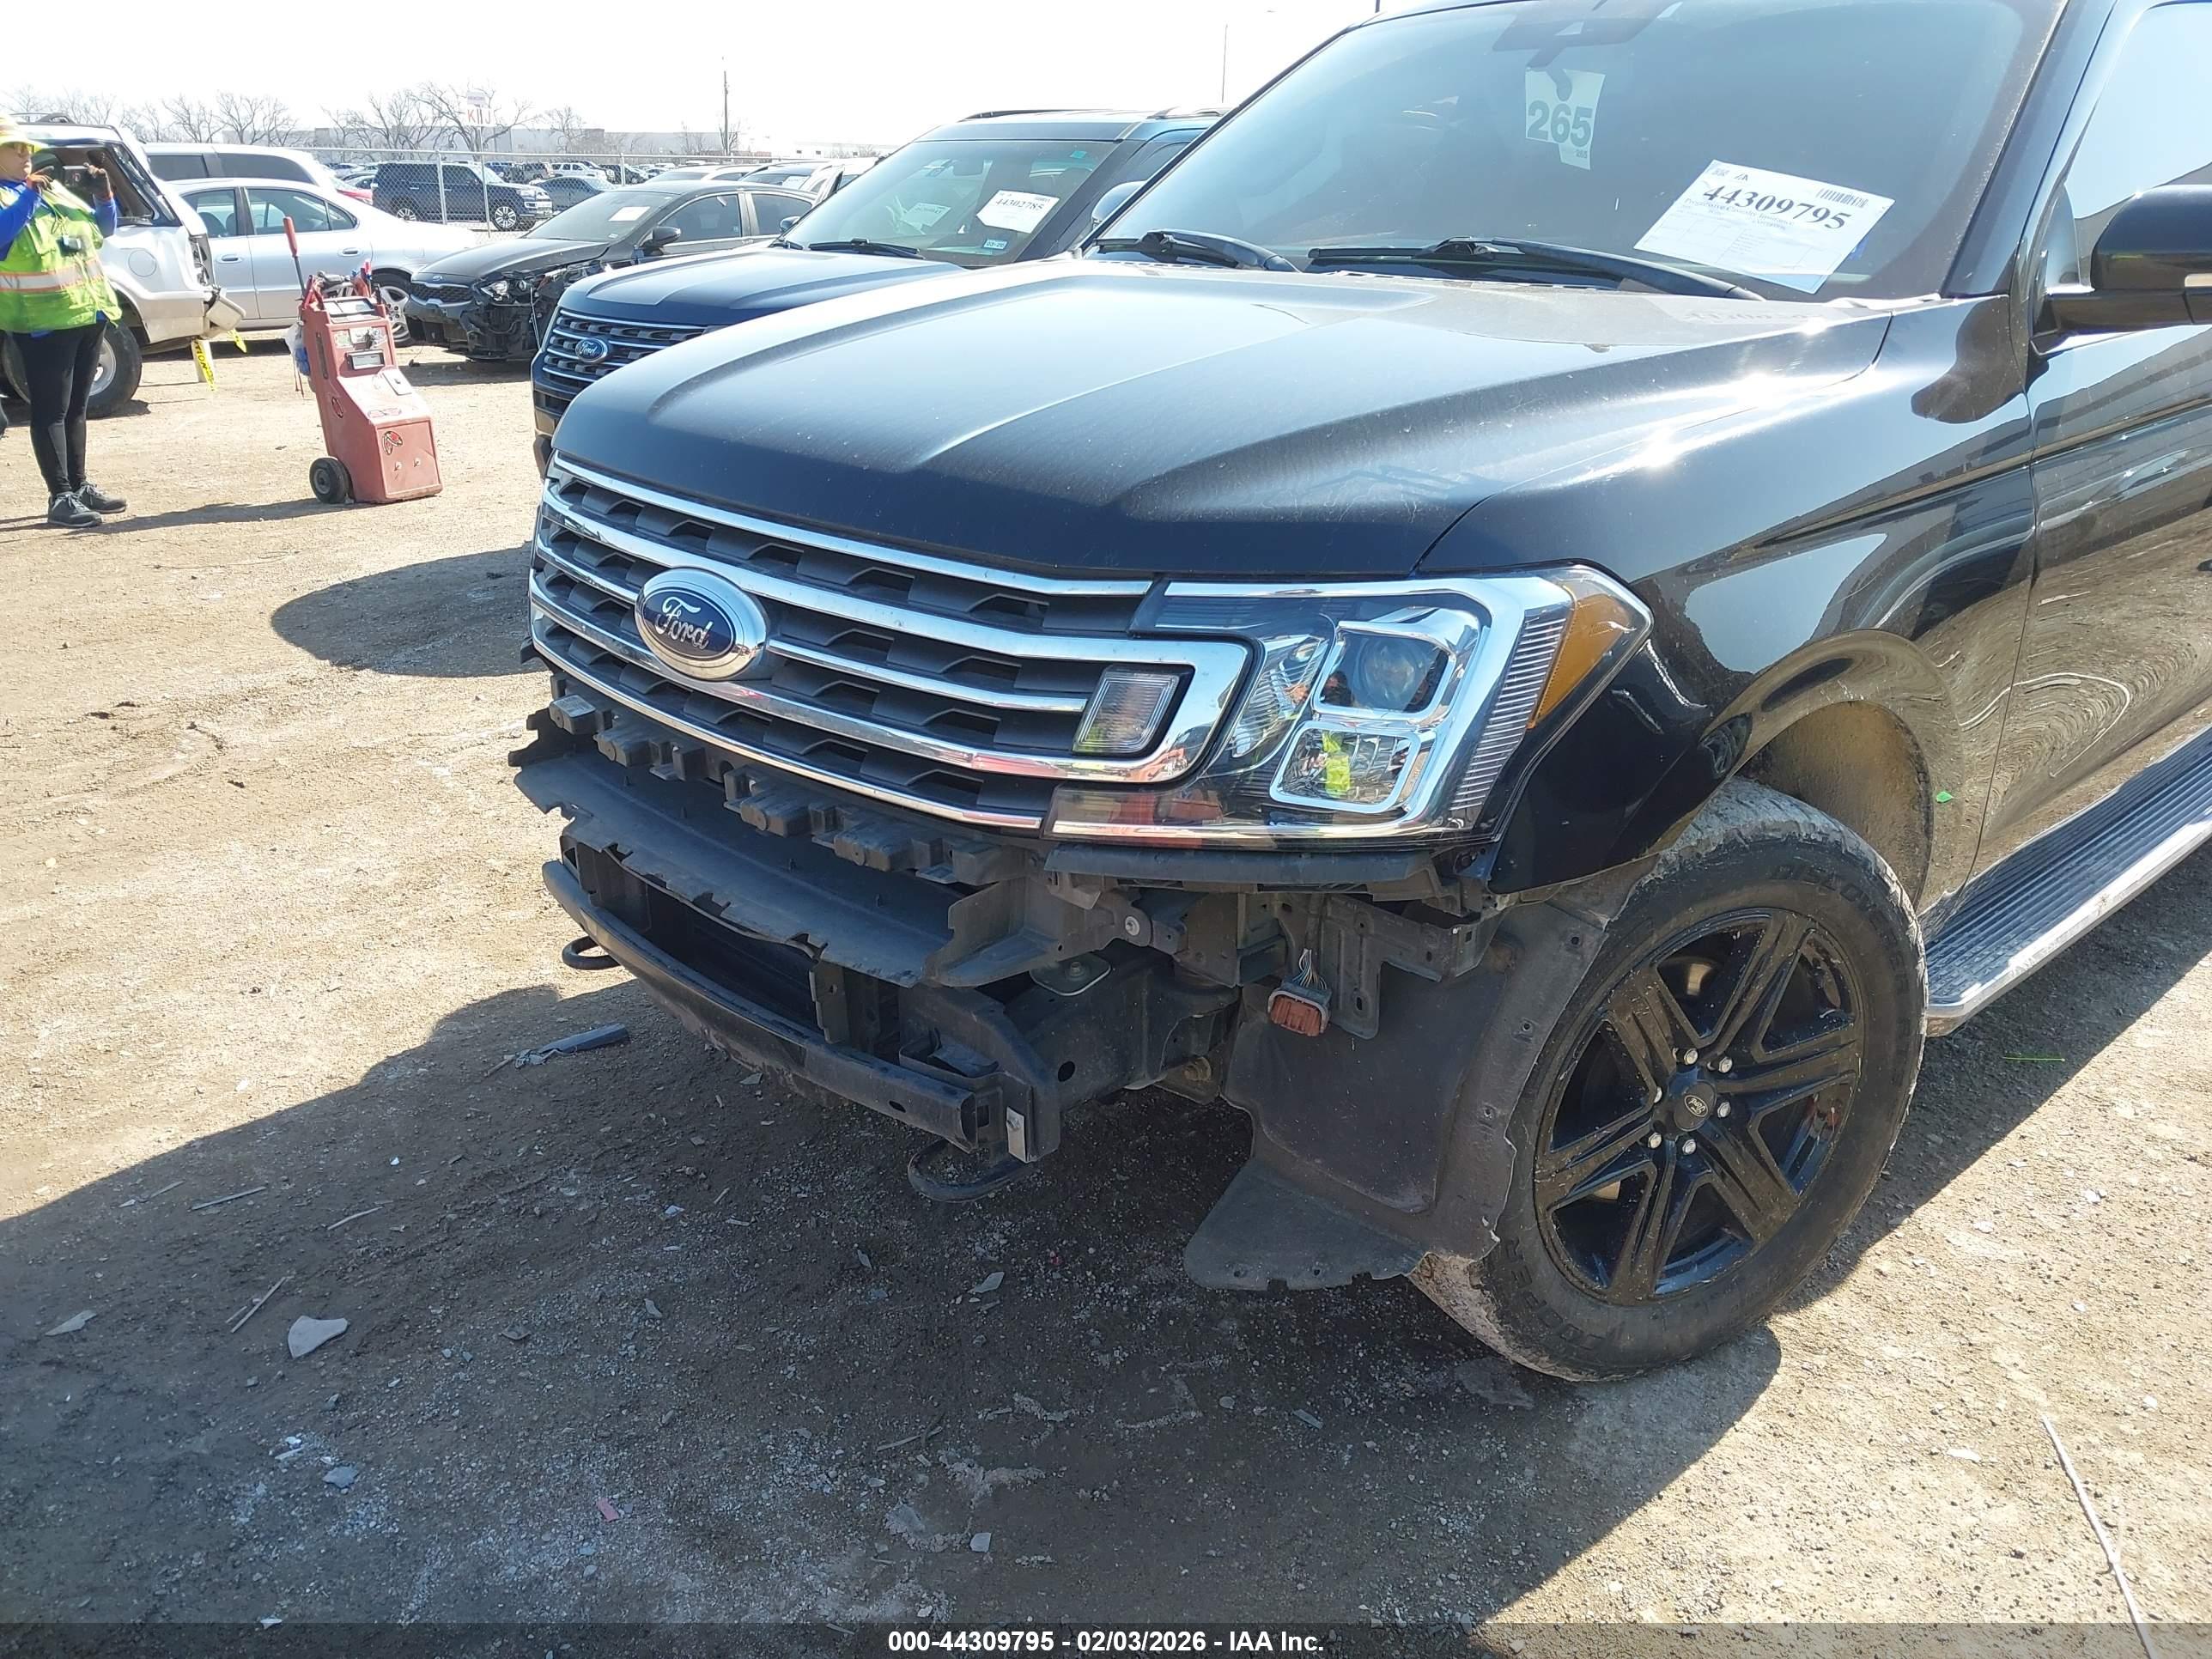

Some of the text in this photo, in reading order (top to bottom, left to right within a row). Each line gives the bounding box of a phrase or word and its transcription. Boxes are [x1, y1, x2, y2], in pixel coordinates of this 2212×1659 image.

[1528, 100, 1593, 147] 265
[1702, 185, 1852, 230] 44309795
[580, 341, 598, 355] Ford
[655, 596, 714, 650] Ford
[1688, 1097, 1706, 1115] Ford
